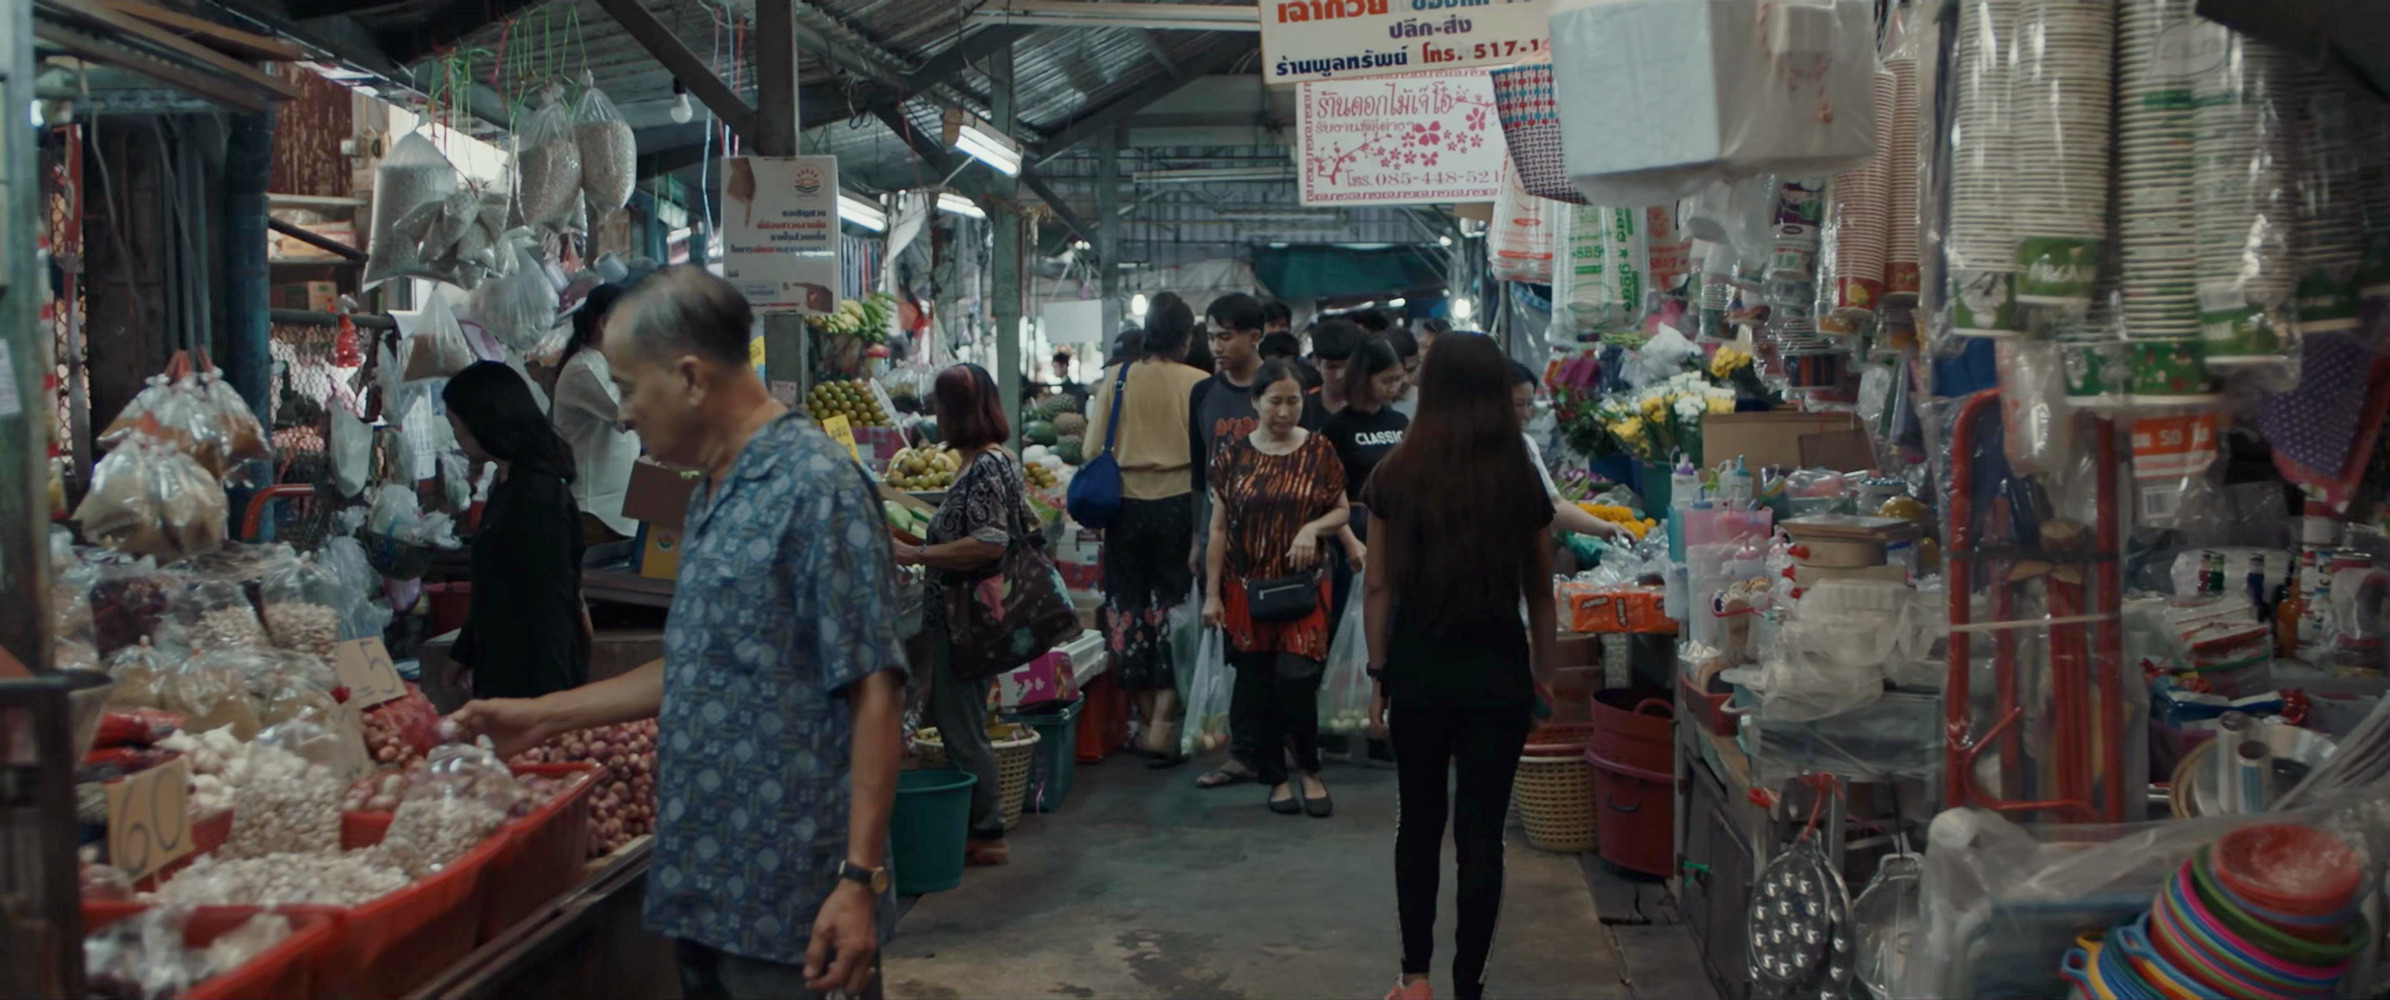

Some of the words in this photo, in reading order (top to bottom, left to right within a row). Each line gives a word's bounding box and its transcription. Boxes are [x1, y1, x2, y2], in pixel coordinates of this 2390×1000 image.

[1278, 0, 1388, 23] เฉากวย
[1275, 45, 1408, 78] ร้านพูลทรัพย์
[1422, 41, 1463, 64] โทร.
[116, 766, 184, 878] 60
